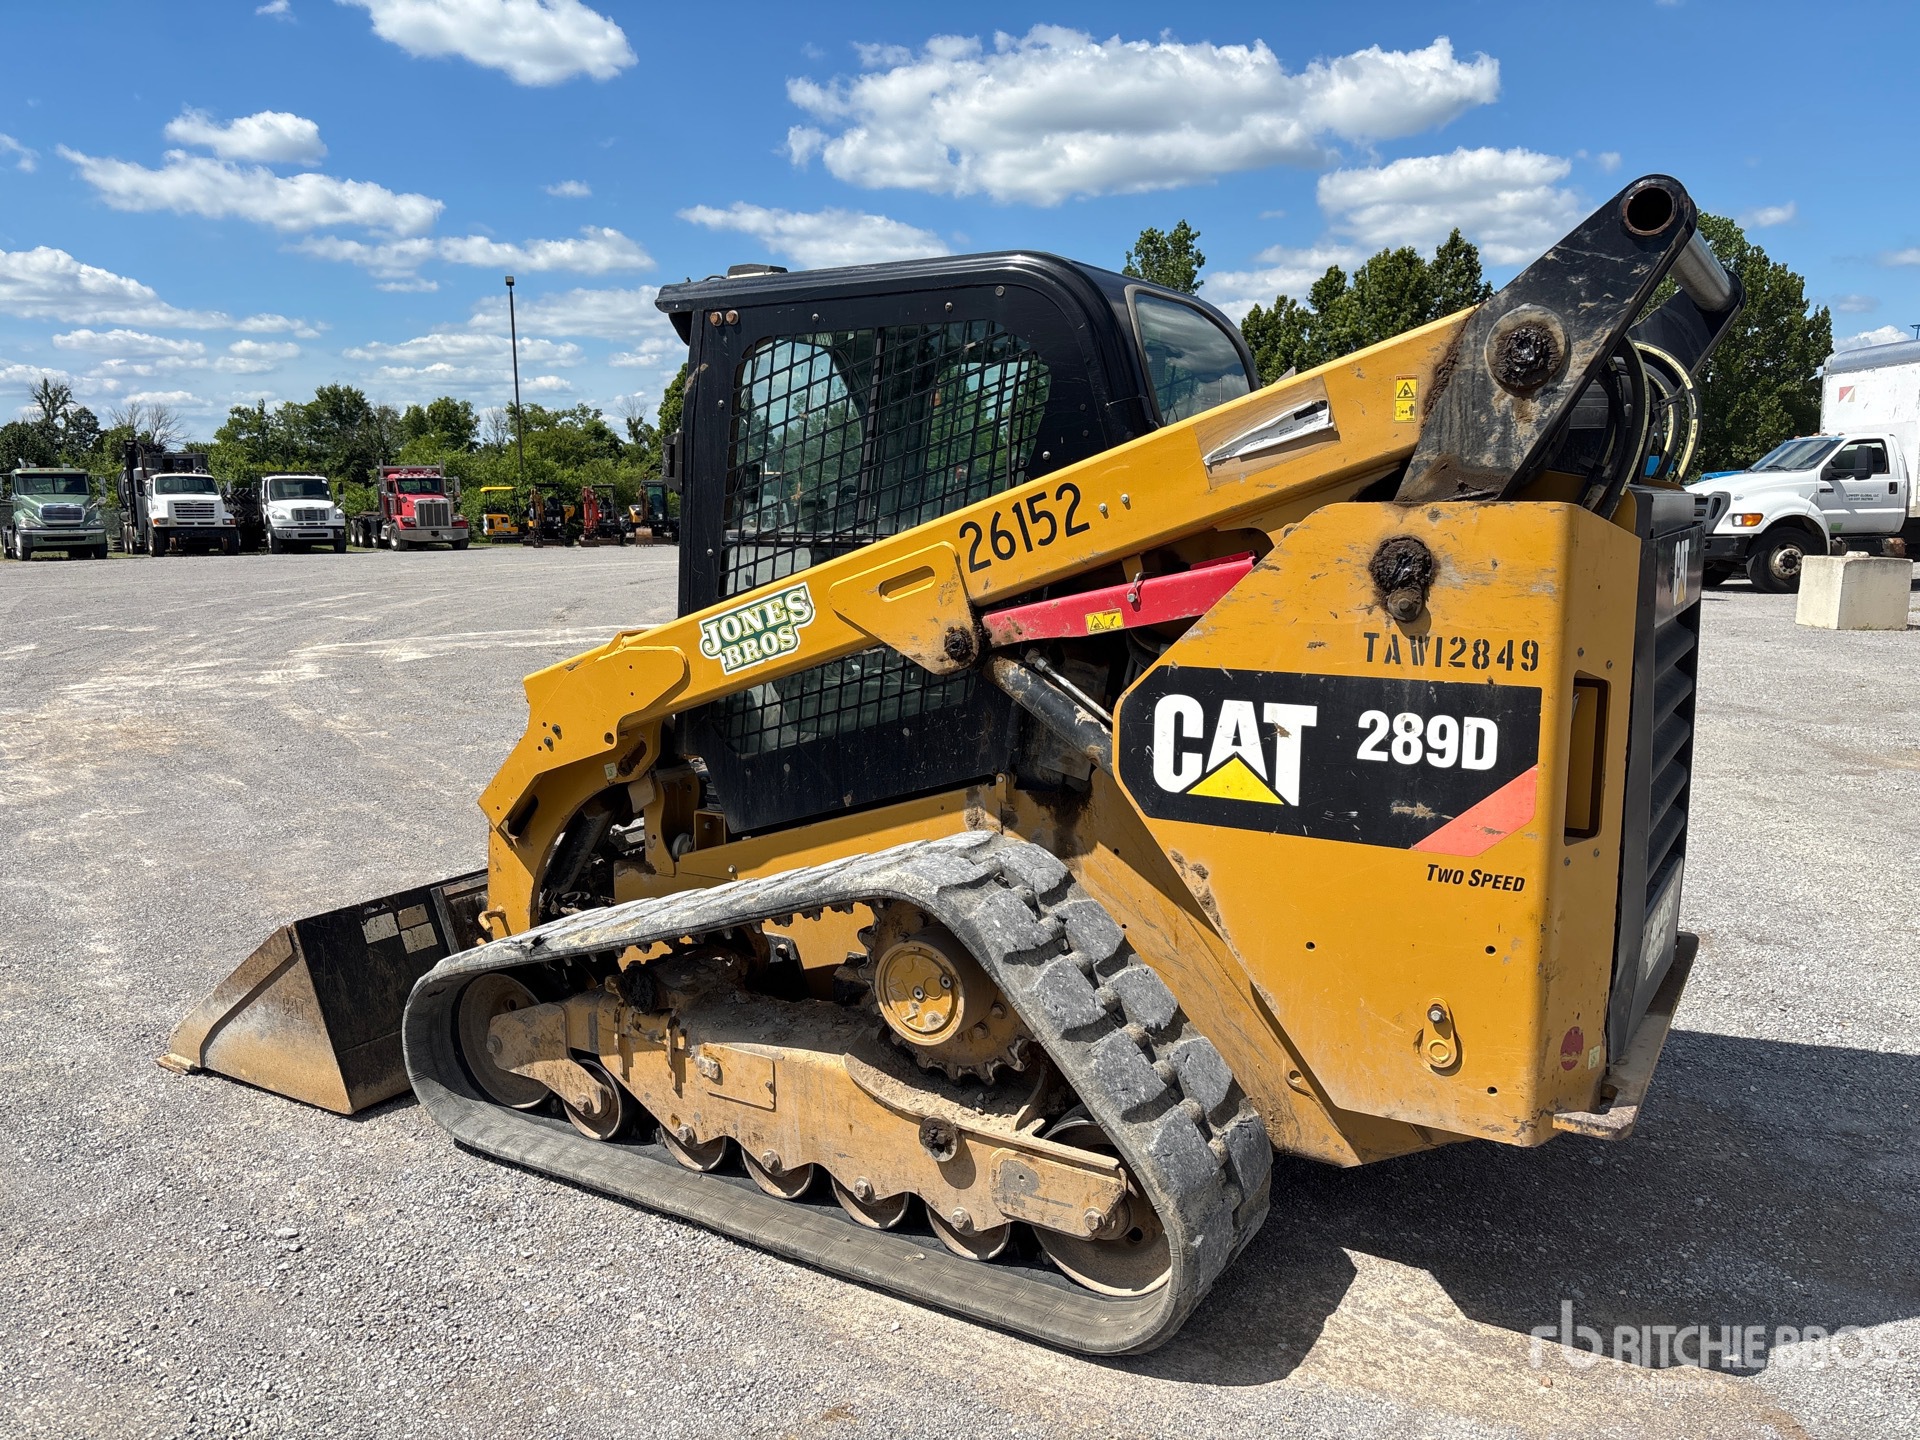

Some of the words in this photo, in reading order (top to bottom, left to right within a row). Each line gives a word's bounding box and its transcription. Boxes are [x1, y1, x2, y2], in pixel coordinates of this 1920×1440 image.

[959, 483, 1090, 573] 26152
[1674, 539, 1690, 606] CAT
[702, 588, 812, 656] JONES
[722, 624, 797, 669] BROS
[1153, 693, 1318, 806] CAT
[1357, 709, 1499, 771] 289D
[1427, 863, 1464, 885] TWO
[1468, 868, 1526, 893] SPEED
